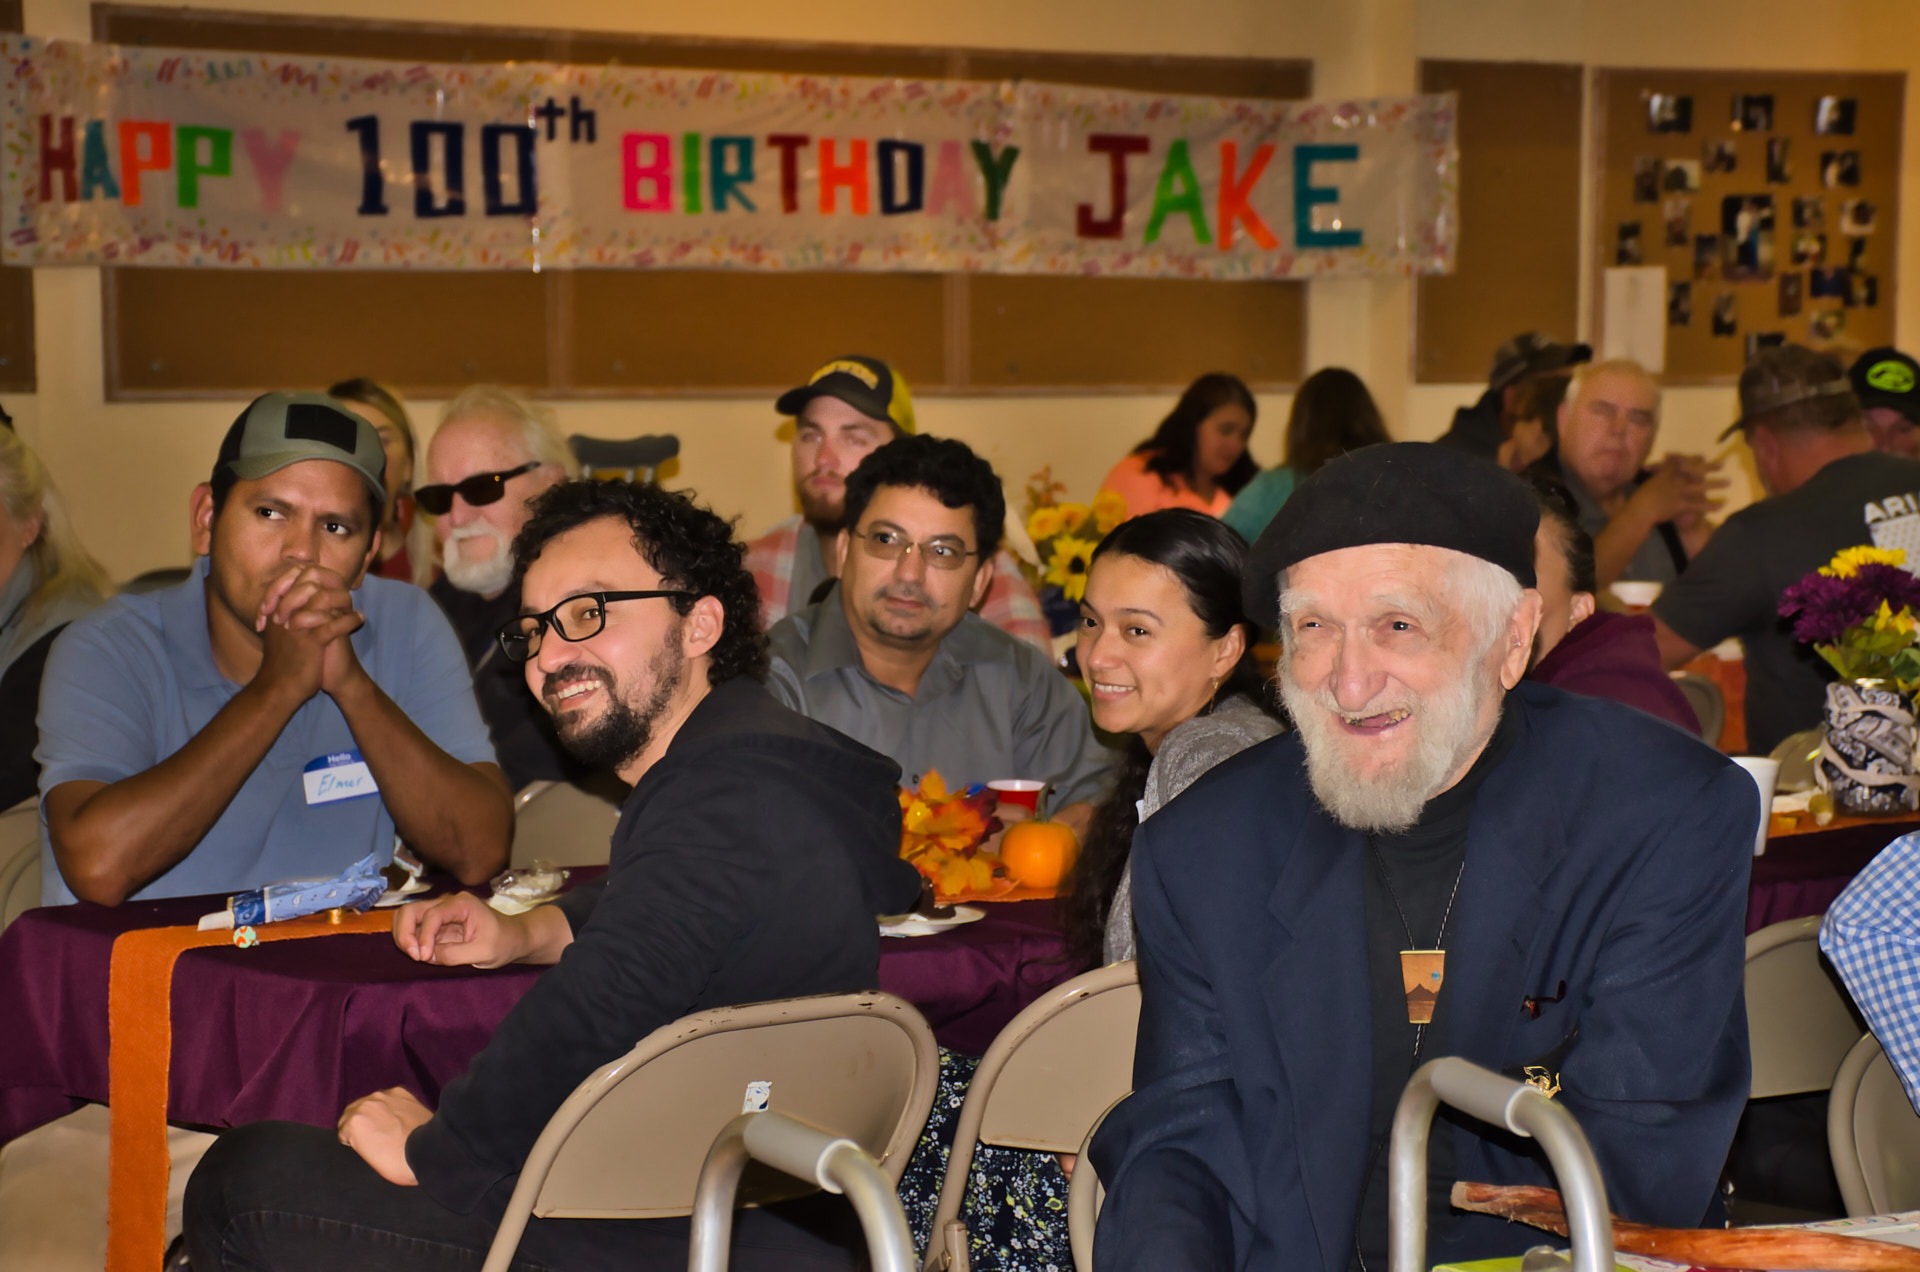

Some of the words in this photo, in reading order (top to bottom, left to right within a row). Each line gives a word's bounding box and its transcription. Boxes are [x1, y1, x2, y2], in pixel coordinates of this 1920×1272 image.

[39, 112, 298, 212] HAPPY
[621, 132, 1020, 221] BIRTHDAY
[1076, 134, 1363, 250] JAKE
[1864, 491, 1920, 524] ARI
[327, 753, 352, 763] Hello
